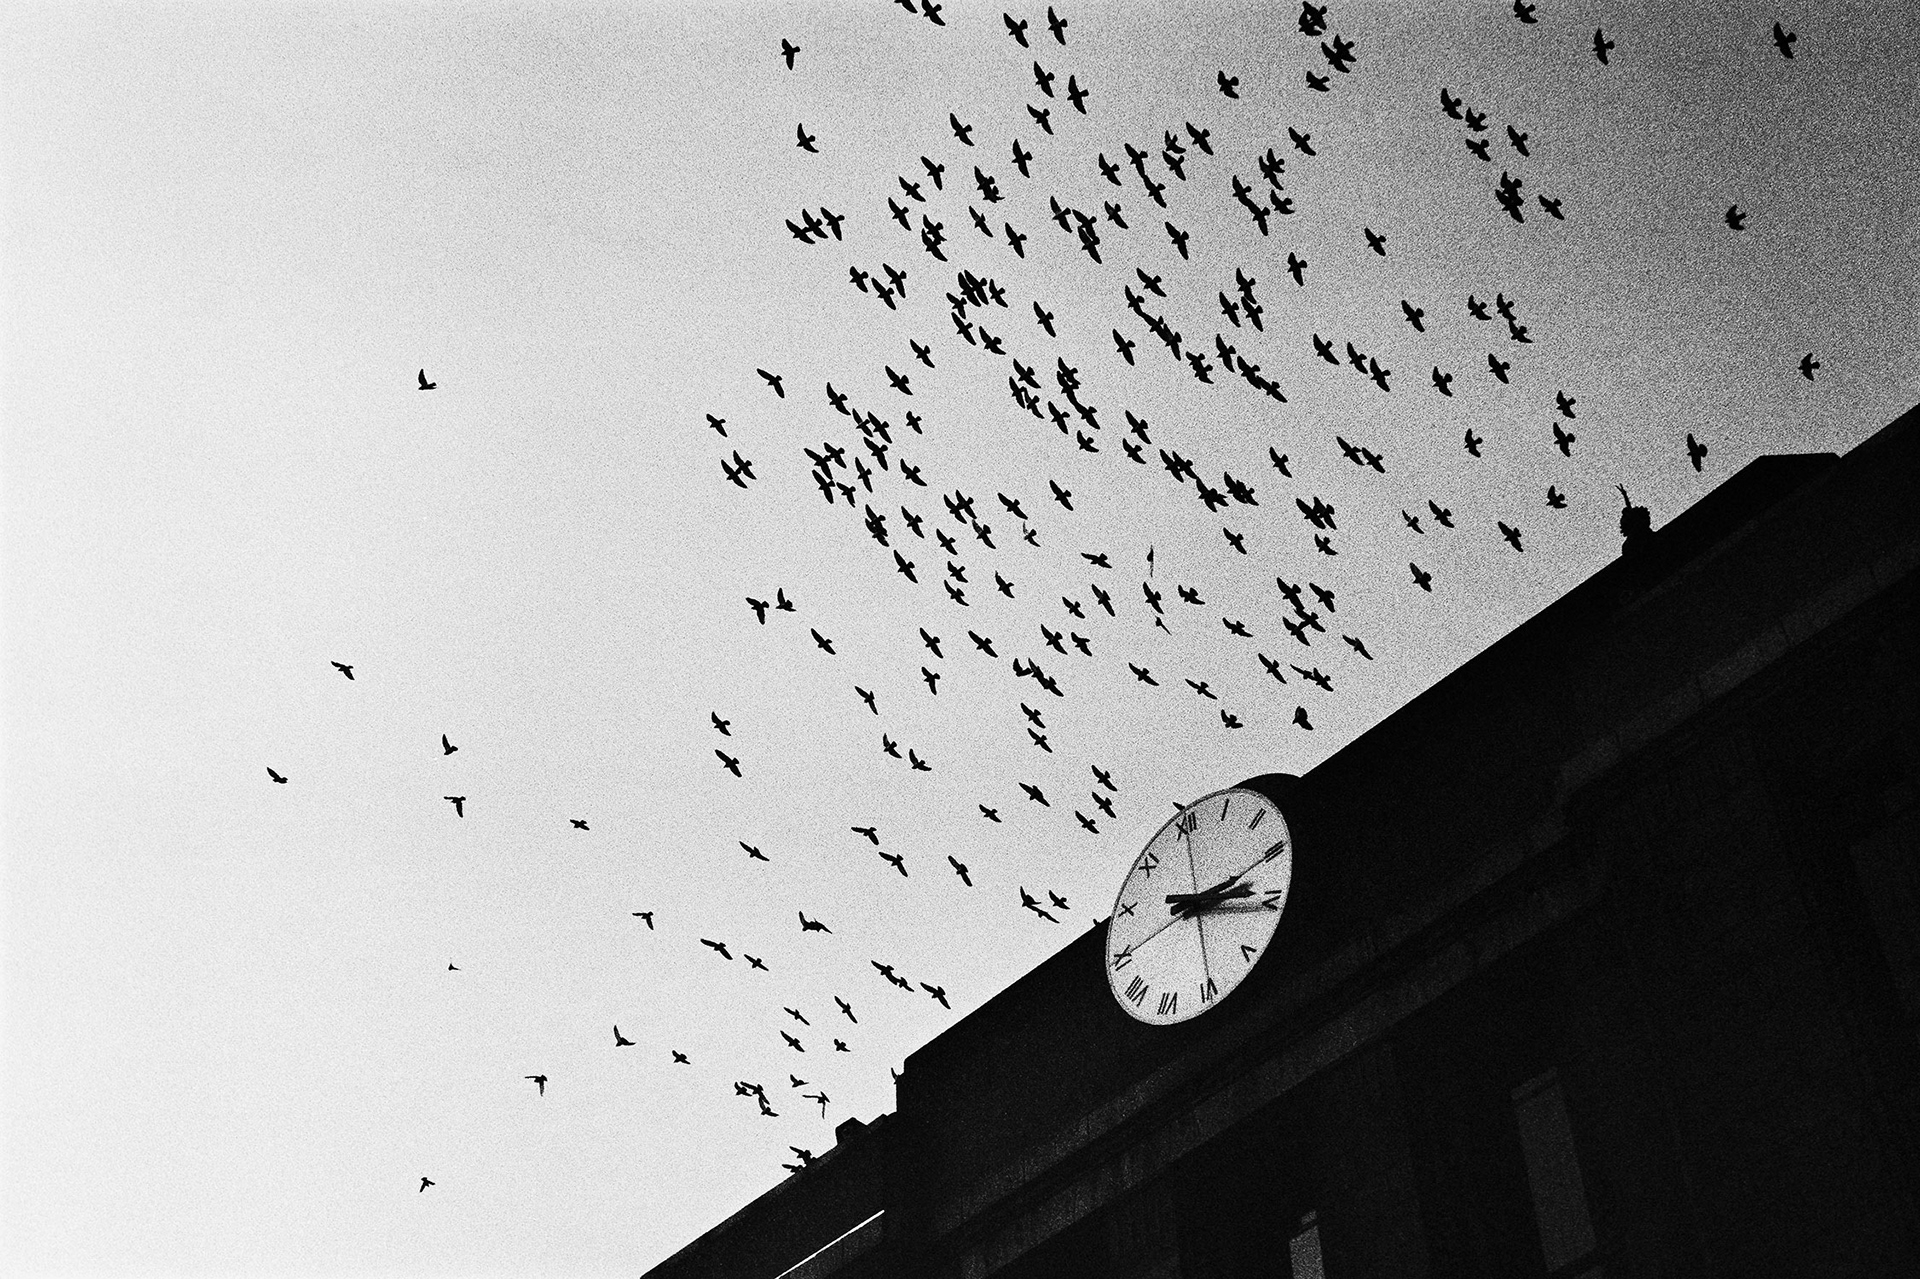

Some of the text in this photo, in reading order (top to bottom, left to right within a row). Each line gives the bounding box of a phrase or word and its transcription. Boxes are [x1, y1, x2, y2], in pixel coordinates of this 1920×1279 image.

[1221, 799, 1229, 821] I
[1249, 808, 1266, 830] II
[1176, 812, 1197, 841] XII
[1264, 840, 1285, 863] III
[1138, 852, 1159, 878] XI
[1118, 901, 1138, 917] X
[1240, 945, 1256, 962] V
[1200, 978, 1218, 1002] VI
[1157, 992, 1178, 1015] VII
